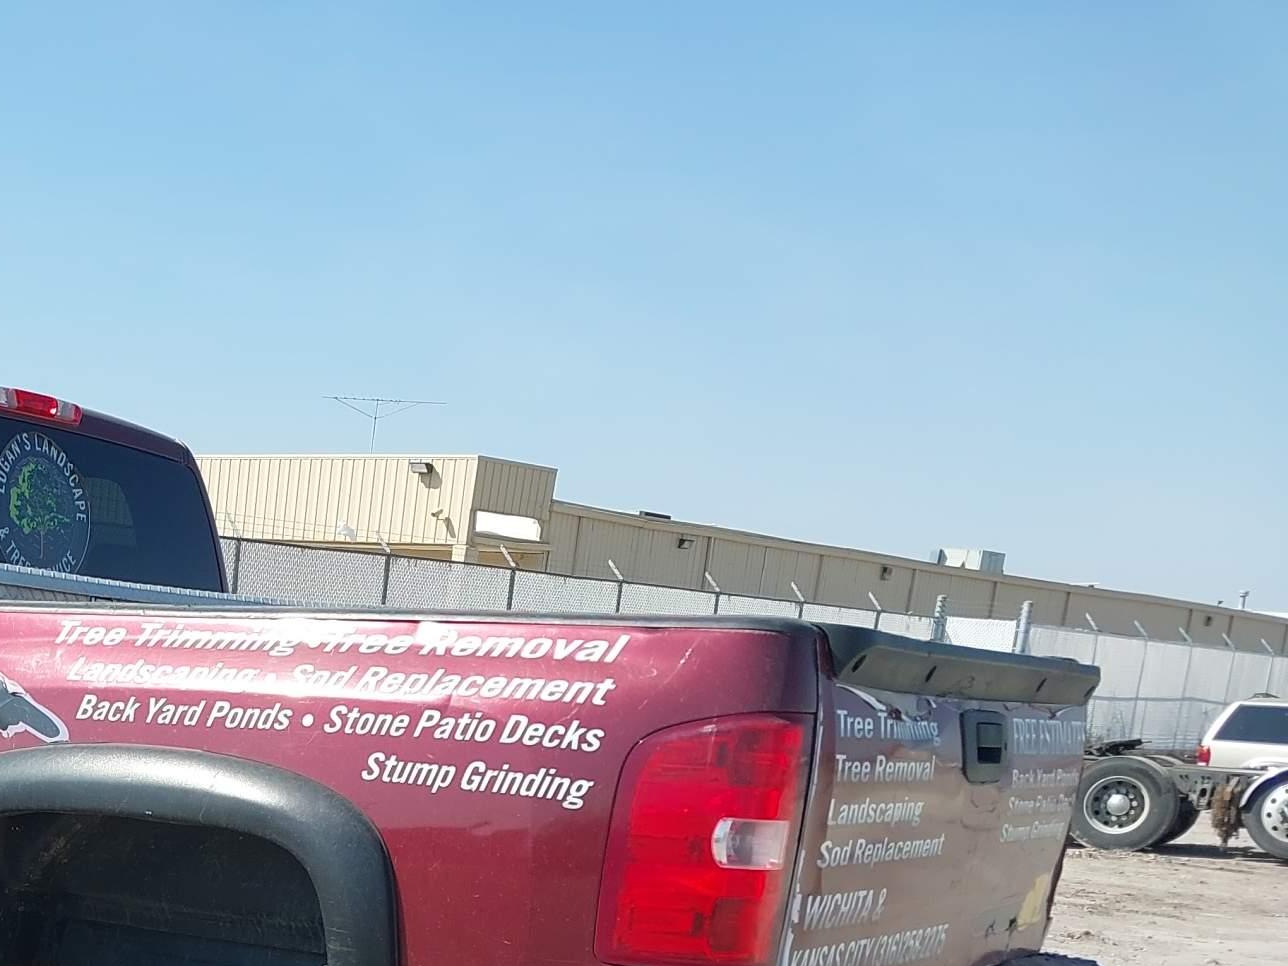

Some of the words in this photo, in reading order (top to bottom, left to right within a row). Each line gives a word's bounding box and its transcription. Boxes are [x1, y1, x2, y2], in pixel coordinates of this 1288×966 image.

[34, 433, 86, 523] LANDSCAPE
[0, 527, 9, 541] &
[56, 619, 125, 647] Tree
[134, 622, 296, 657] Trimming
[418, 625, 632, 664] Removal
[356, 666, 617, 707] Replacement
[76, 694, 136, 723] Back
[144, 697, 201, 728] Yard
[207, 700, 293, 732] Ponds
[324, 705, 406, 736] Stone
[414, 708, 496, 743] Patio
[500, 713, 606, 752] Decks
[836, 709, 875, 739] Tree
[362, 751, 455, 793] Stump
[461, 762, 594, 810] Grinding
[835, 754, 872, 783] Tree
[875, 755, 937, 783] Removal
[828, 796, 925, 827] Landscaping
[816, 840, 854, 870] Sod
[854, 832, 946, 868] Replacement
[803, 889, 875, 931] WICHITA
